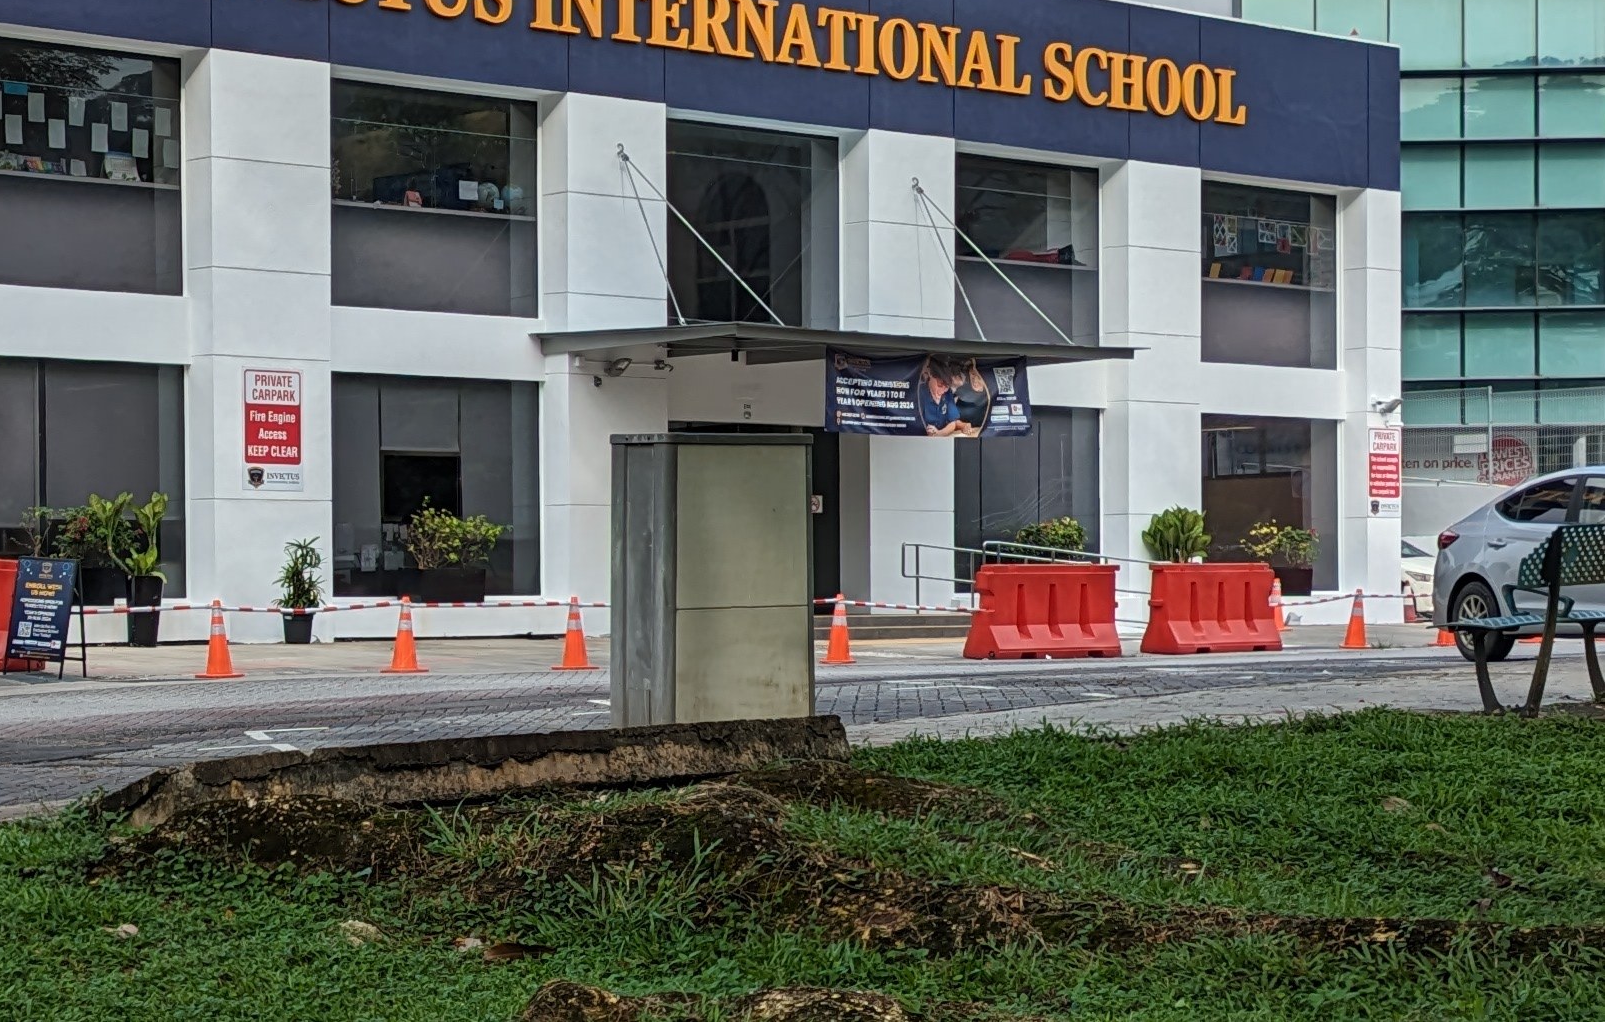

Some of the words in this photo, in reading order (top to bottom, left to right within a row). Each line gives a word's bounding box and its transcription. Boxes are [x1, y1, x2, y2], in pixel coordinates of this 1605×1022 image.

[1043, 42, 1247, 126] SCHOOL
[254, 374, 293, 388] PRIVATE
[252, 388, 296, 402] CARPARK
[850, 388, 866, 397] FOR
[890, 390, 898, 399] TO
[249, 410, 266, 422] Fire
[268, 411, 296, 425] Engine
[258, 428, 287, 440] Access
[1373, 431, 1396, 441] PRIVATE
[247, 445, 269, 457] KEEP
[270, 445, 299, 458] CLEAR
[1372, 442, 1398, 452] CARPARK
[1423, 459, 1439, 469] on
[1442, 456, 1474, 471] price.
[266, 472, 300, 480] INVICTUS
